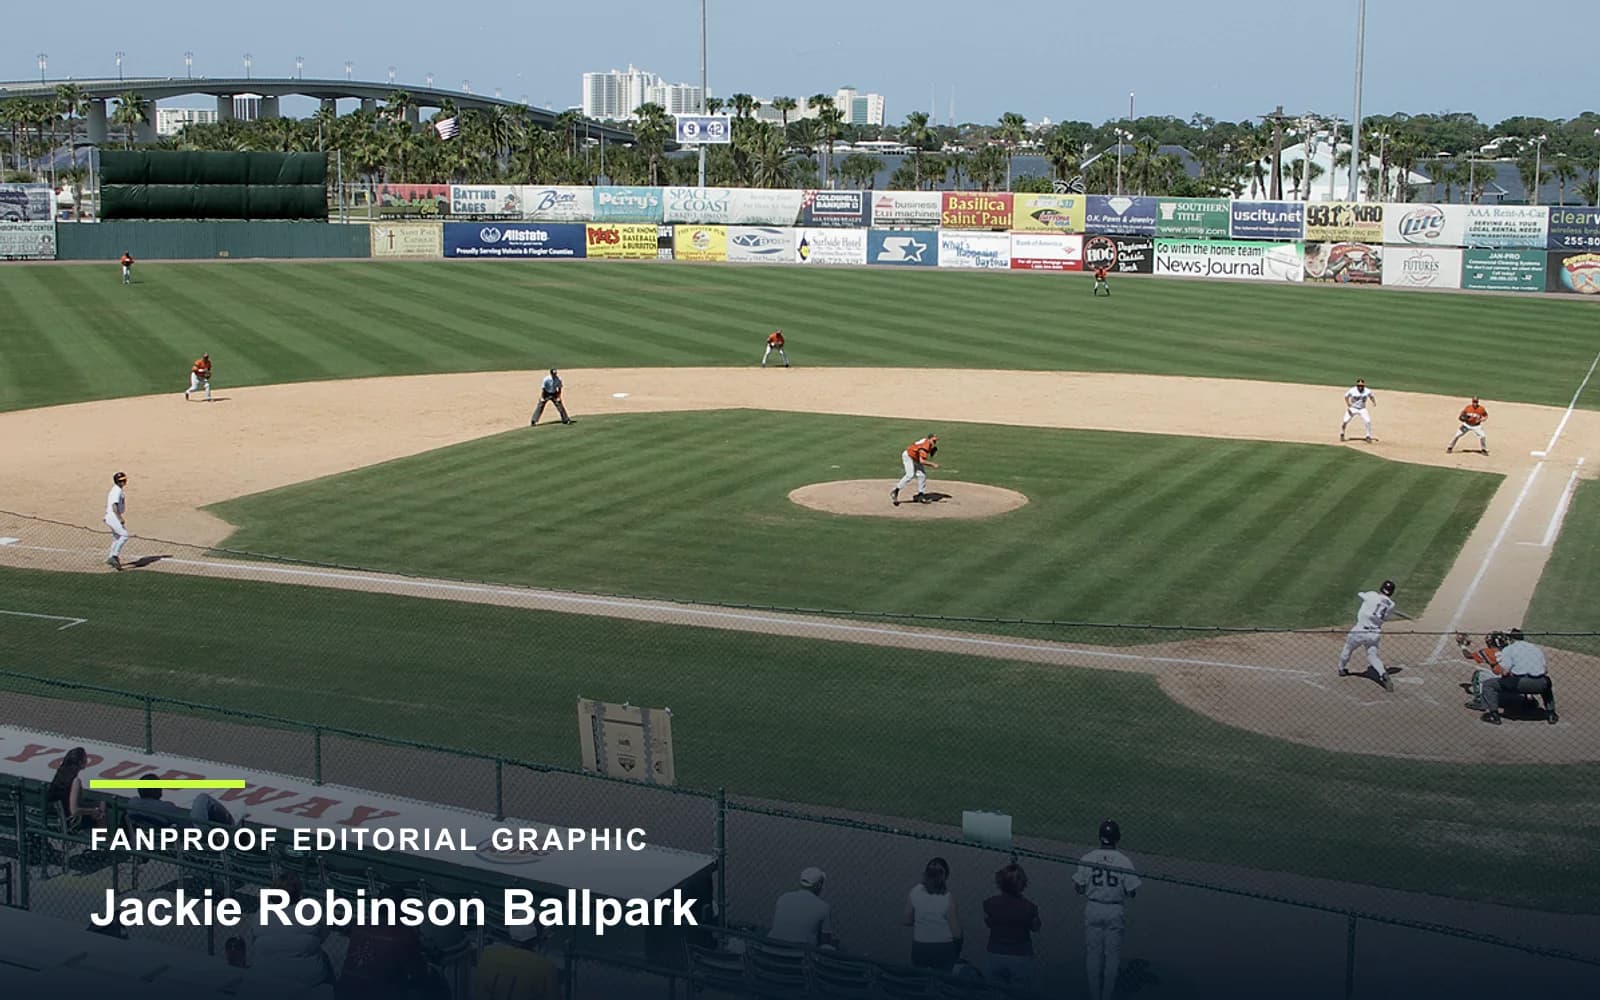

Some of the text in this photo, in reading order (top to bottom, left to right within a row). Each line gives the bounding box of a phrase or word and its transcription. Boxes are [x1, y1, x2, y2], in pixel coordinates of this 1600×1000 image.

[688, 124, 695, 134] 9
[709, 124, 721, 135] 42
[453, 187, 496, 200] BATTING
[670, 189, 708, 200] SPACE
[453, 200, 486, 212] CAGES
[599, 192, 658, 208] Perry's
[683, 200, 729, 212] COAST
[948, 197, 1005, 210] Basilica
[1177, 202, 1229, 212] SOUTHERN
[1468, 208, 1546, 218] AAA Rent-A-Car
[894, 209, 940, 218] machines
[943, 212, 1012, 226] Saint Paul
[1177, 212, 1204, 221] TITLE
[1234, 208, 1302, 224] uscity.net
[1307, 205, 1338, 226] 93.1
[1403, 215, 1444, 236] Lite
[502, 230, 549, 241] Allstate
[1086, 248, 1114, 262] HOG
[1157, 242, 1264, 256] Go with the home team!
[976, 256, 1009, 268] Daytona
[1156, 256, 1264, 276] News-Journal
[1403, 260, 1439, 271] FUTURES
[219, 782, 401, 827] WAY
[1092, 865, 1118, 887] 26
